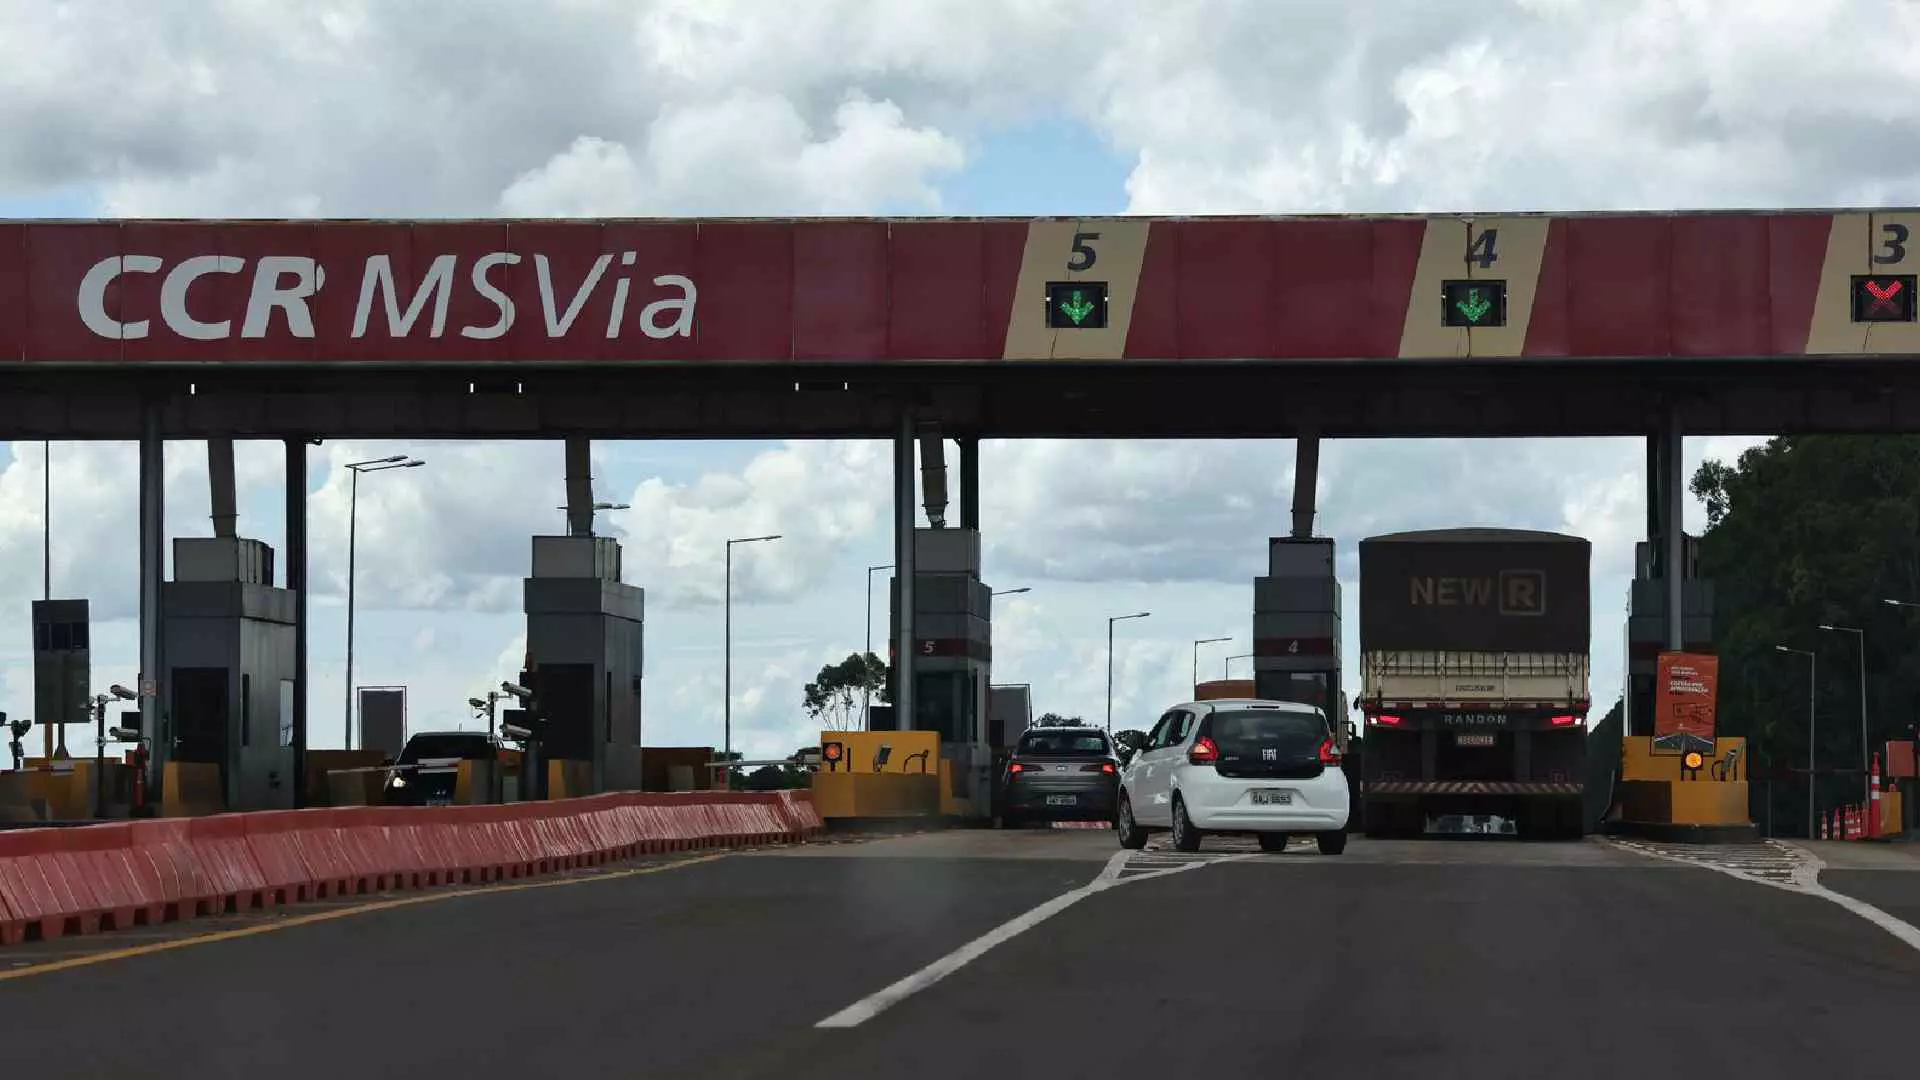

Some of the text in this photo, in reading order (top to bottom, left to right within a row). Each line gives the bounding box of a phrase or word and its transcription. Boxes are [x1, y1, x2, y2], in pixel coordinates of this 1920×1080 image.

[1067, 232, 1101, 272] 5
[1463, 229, 1497, 268] 4
[1873, 223, 1909, 264] 3
[78, 251, 697, 340] CCR MSVia
[1410, 576, 1492, 606] NEW
[923, 640, 936, 653] 5
[1287, 639, 1299, 653] 4
[1443, 714, 1507, 725] RANDON
